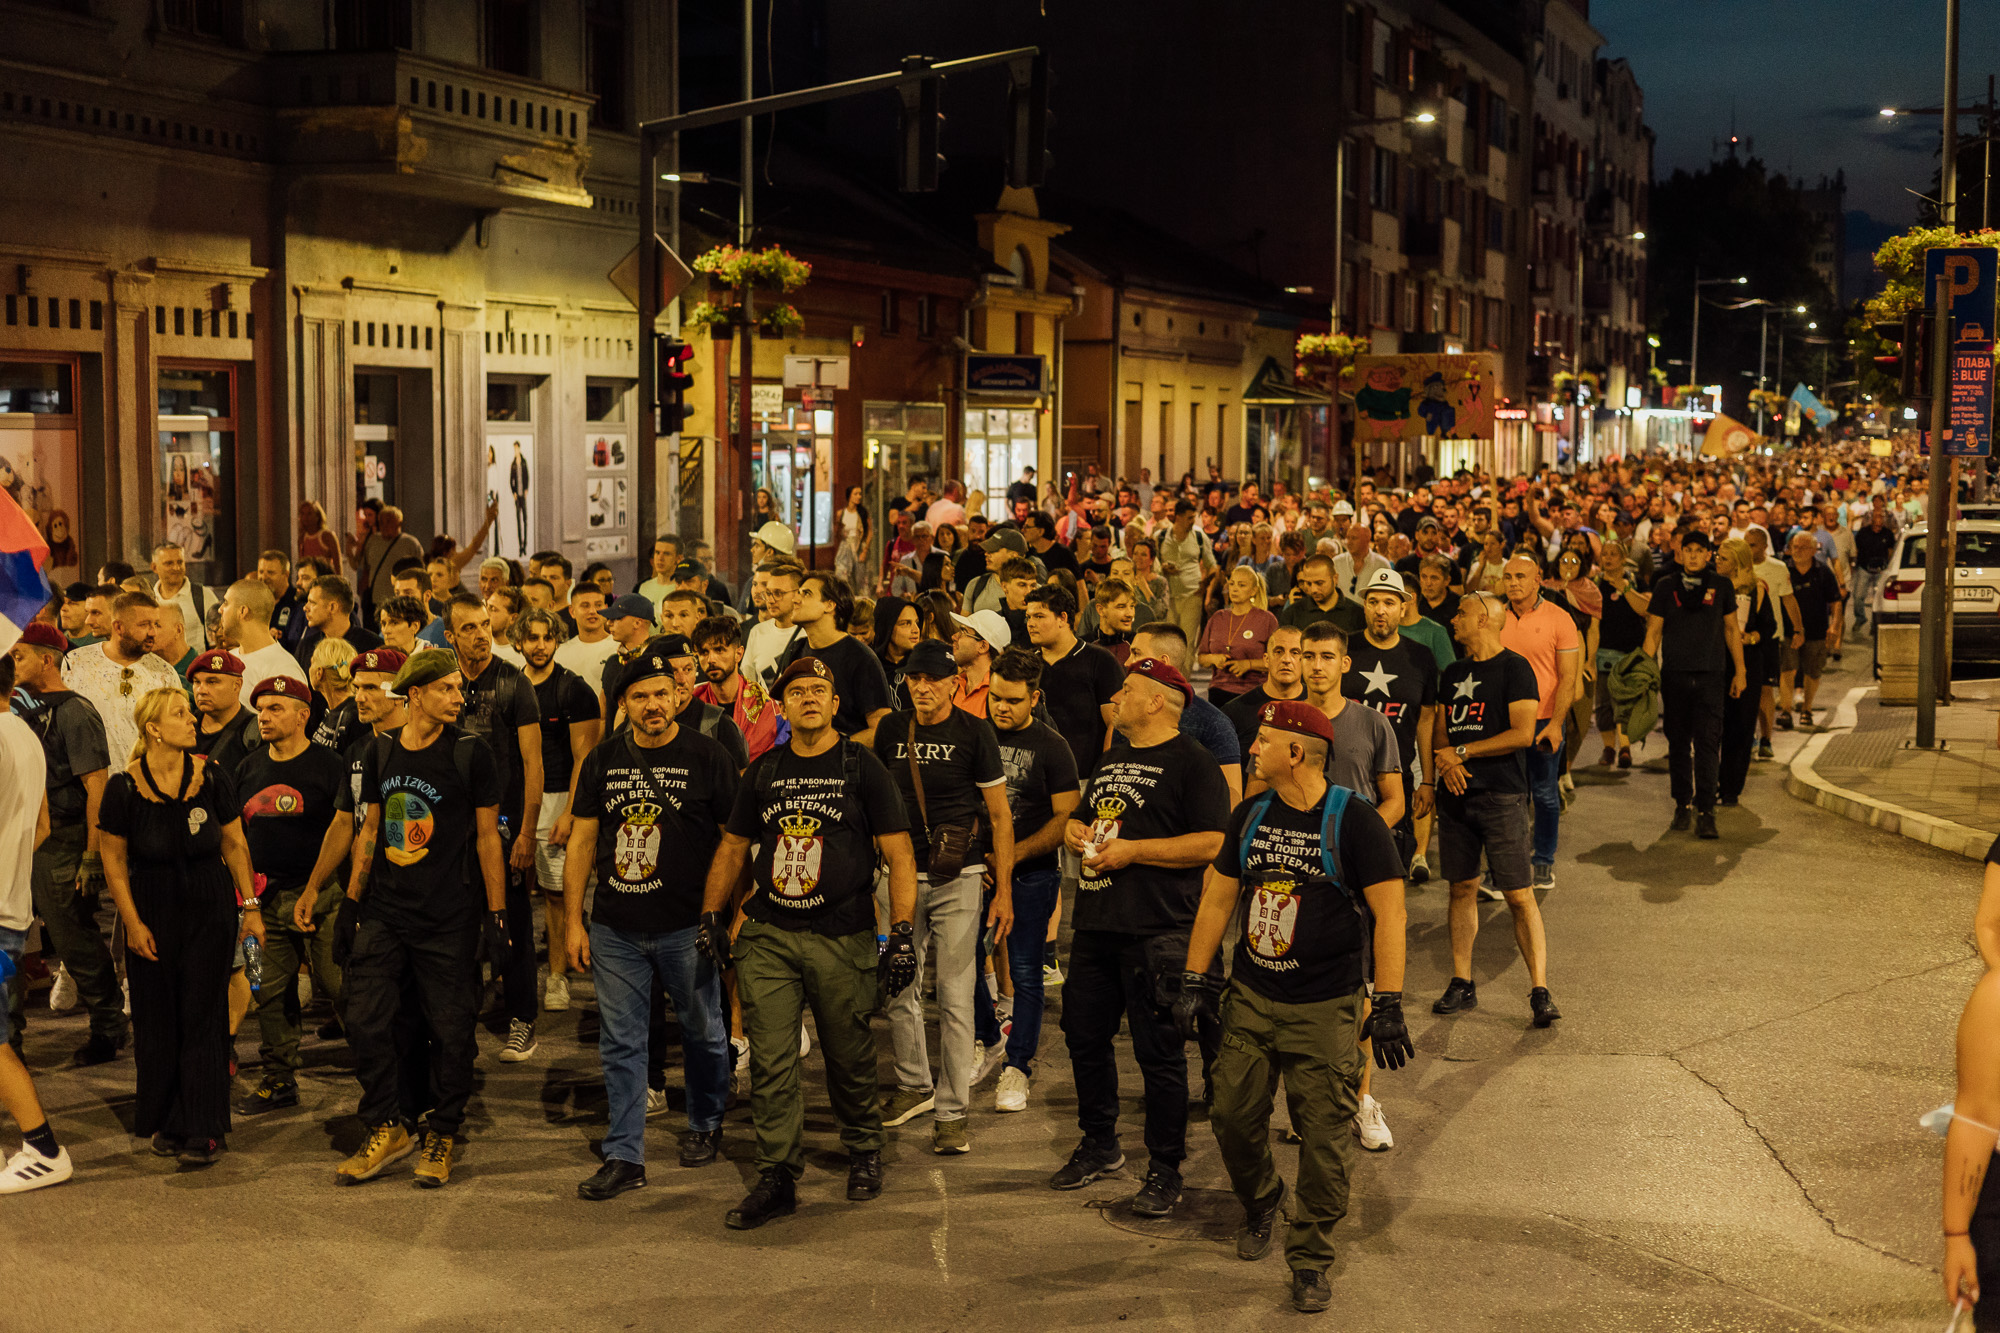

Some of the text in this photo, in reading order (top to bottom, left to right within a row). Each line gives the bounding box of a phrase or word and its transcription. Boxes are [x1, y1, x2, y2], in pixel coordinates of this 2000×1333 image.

[1944, 254, 1981, 311] P
[1957, 357, 1991, 369] ПЛАВА
[1961, 369, 1987, 381] BLUE
[607, 768, 630, 776] МРТВЕ
[650, 767, 690, 776] БОРАВИТЕ
[606, 780, 690, 791] ЖИВЕ ПОТУЈТЕ
[1114, 775, 1158, 788] ПОШТУЈТЕ
[402, 775, 443, 805] IZVORA
[1106, 783, 1146, 809] ВЕТЕРАНА
[605, 790, 683, 814] ДАН ВЕТЕНА
[762, 800, 844, 824] ДАН ВЕТЕРАНА
[1268, 834, 1285, 843] 1991
[1272, 827, 1284, 836] НЕ
[1274, 843, 1323, 857] ПОШТУЈТ
[1246, 853, 1263, 870] АН
[608, 875, 663, 894] ВИДОВДАН
